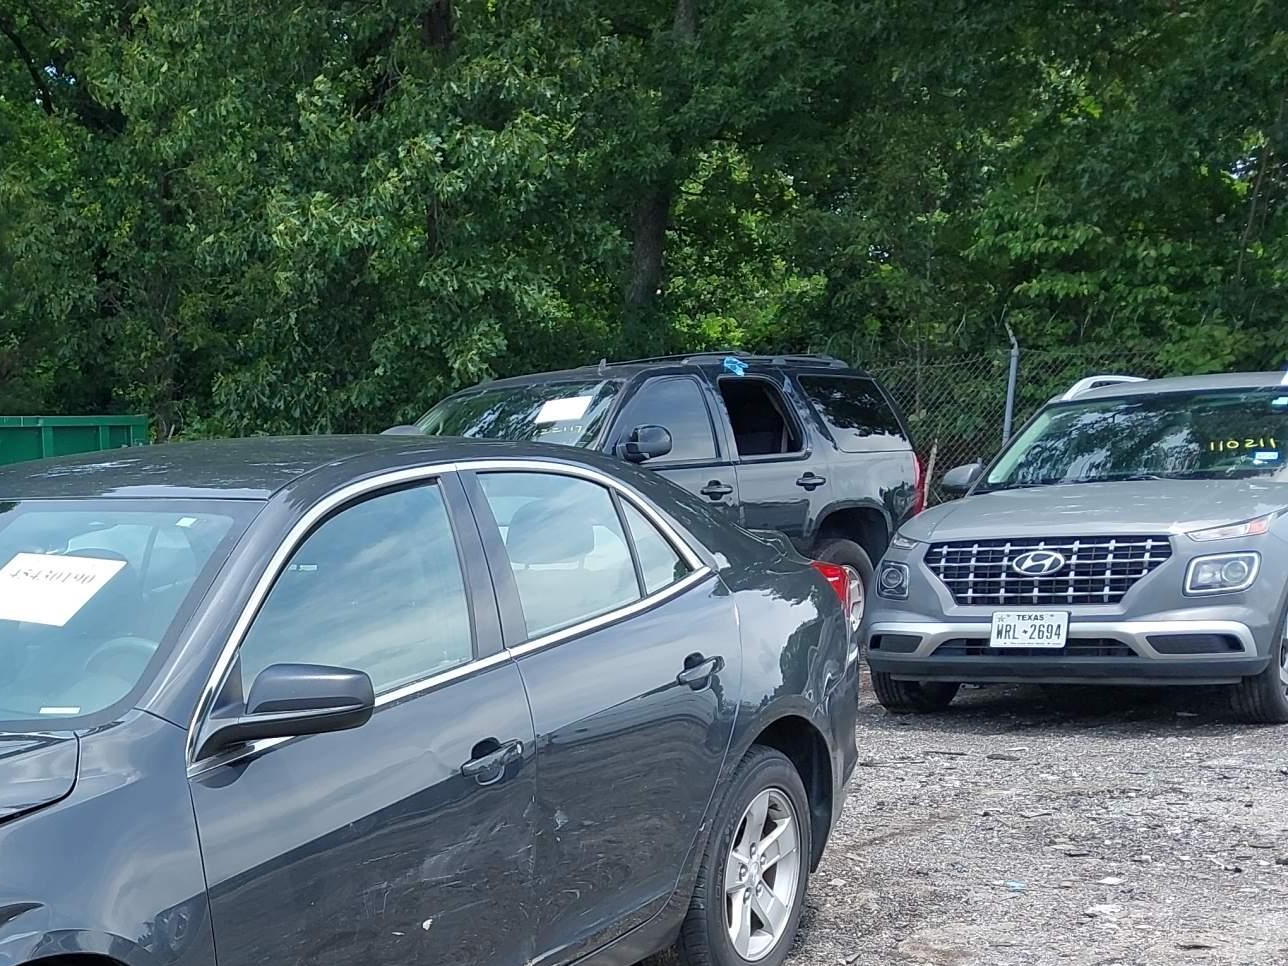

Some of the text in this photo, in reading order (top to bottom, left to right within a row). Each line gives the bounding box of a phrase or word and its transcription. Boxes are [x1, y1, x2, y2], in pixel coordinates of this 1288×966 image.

[1210, 437, 1277, 452] 110211
[996, 623, 1061, 640] WRL 2694
